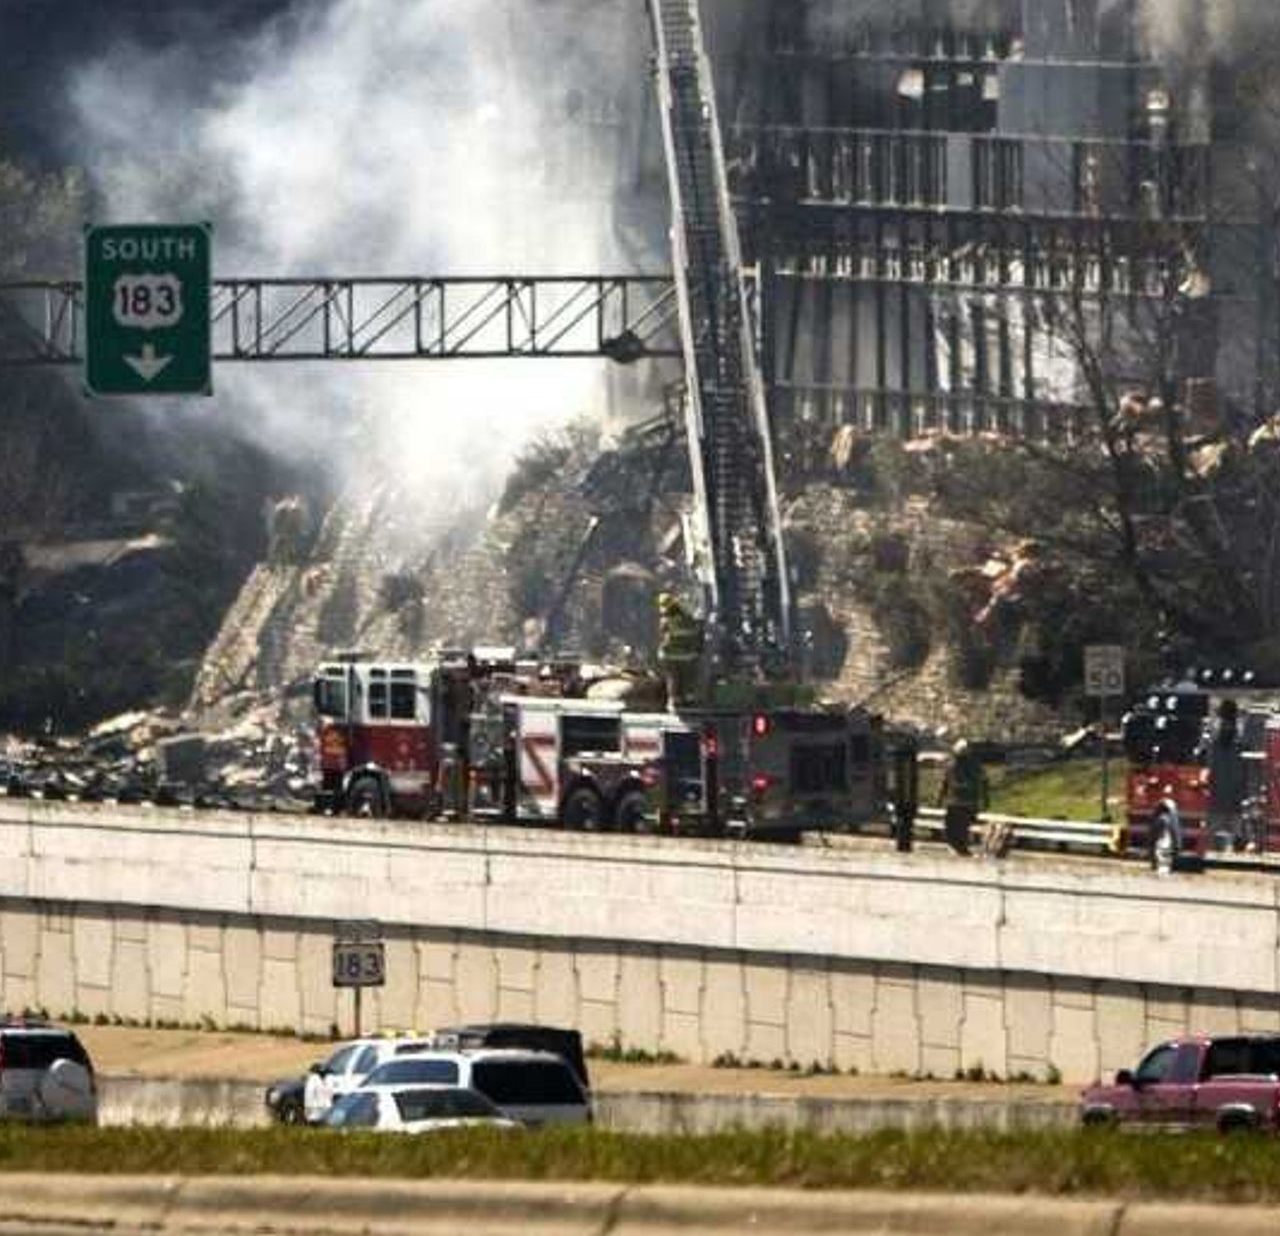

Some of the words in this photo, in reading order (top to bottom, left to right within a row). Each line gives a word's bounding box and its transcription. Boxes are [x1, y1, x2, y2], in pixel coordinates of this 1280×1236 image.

[102, 237, 196, 260] SOUTH
[120, 284, 175, 316] 183
[336, 952, 380, 978] 183
